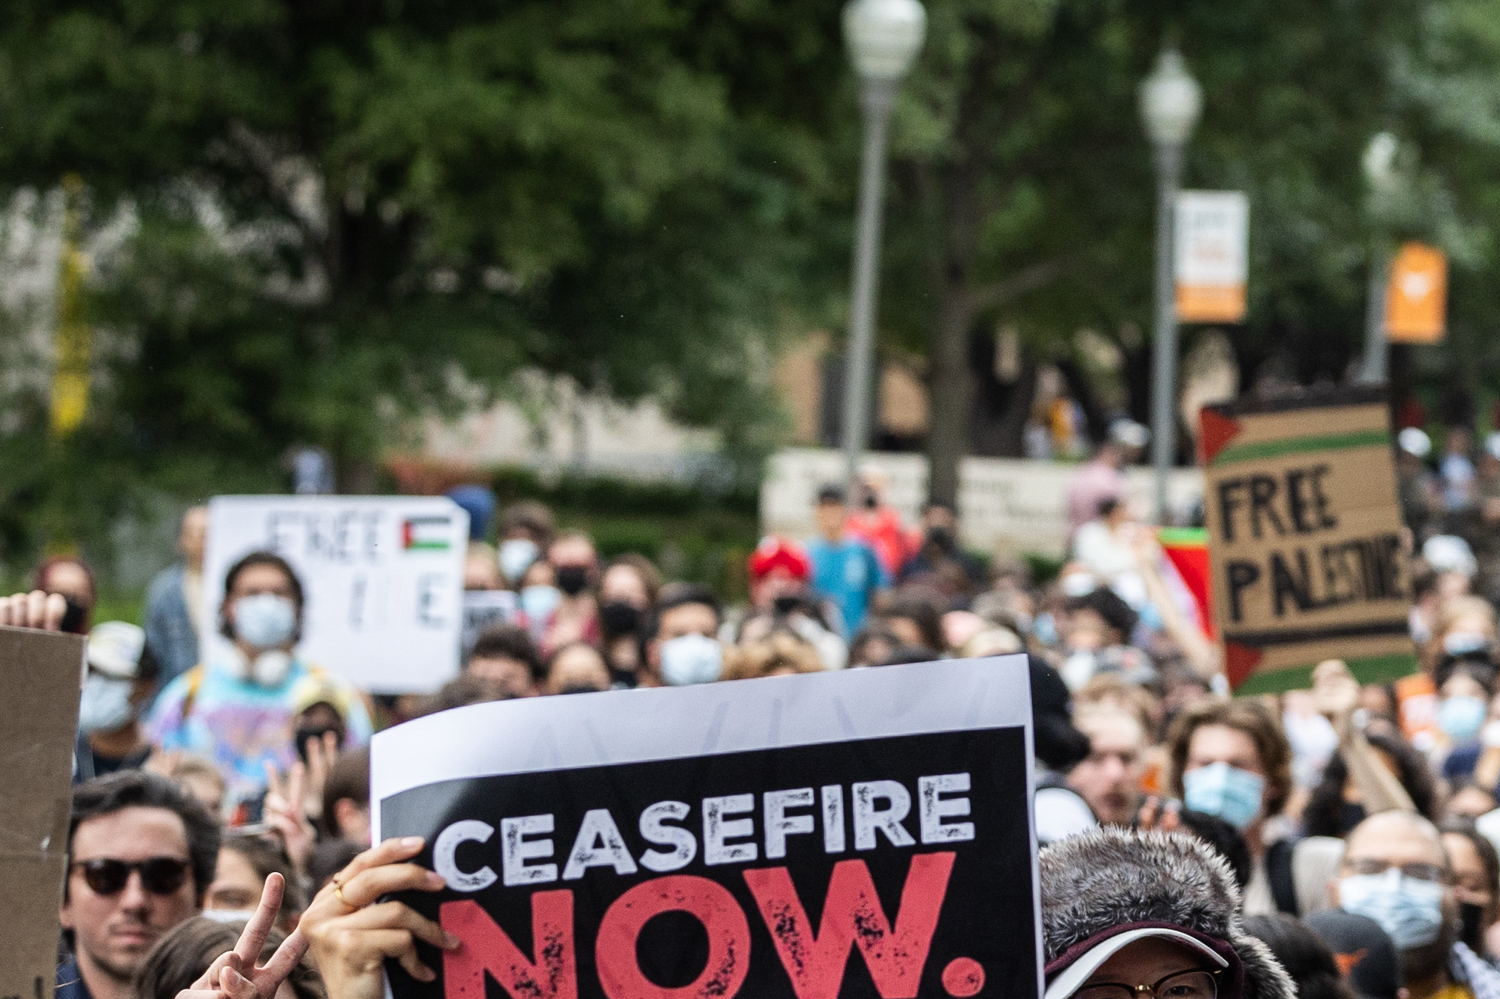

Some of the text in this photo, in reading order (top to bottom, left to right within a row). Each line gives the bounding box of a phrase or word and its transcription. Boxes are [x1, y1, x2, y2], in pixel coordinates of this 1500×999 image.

[1216, 463, 1339, 543] FREE
[1225, 533, 1408, 624] PALESTINE
[433, 772, 975, 892] CEASEFIRE
